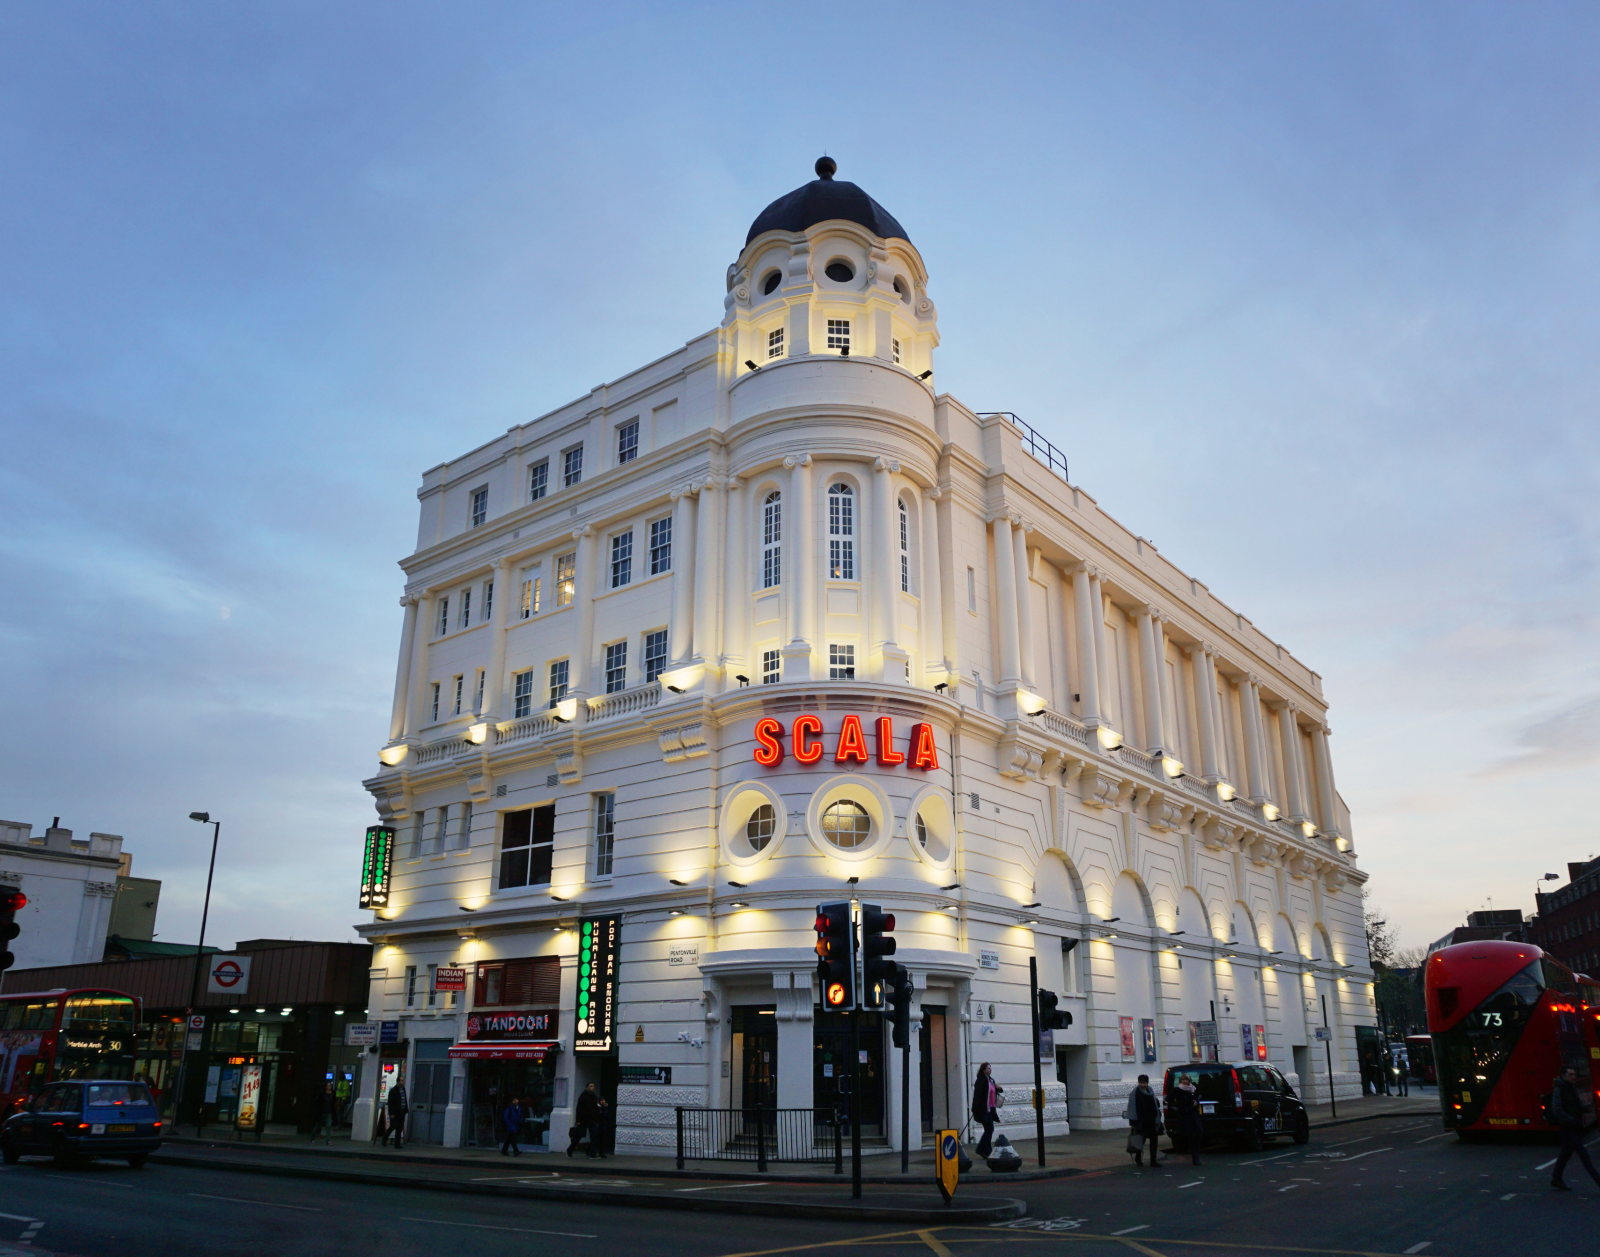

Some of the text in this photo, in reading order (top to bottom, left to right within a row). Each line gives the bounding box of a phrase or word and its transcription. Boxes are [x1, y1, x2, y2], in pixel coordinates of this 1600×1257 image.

[753, 714, 940, 771] SCALA
[383, 832, 393, 872] HURRICANE
[438, 969, 464, 977] INDIAN
[606, 954, 614, 976] BAR
[588, 921, 599, 1034] HURRICANE ROOM
[604, 982, 612, 1033] SNOOKER
[485, 1015, 548, 1031] TANDOORI
[1482, 1012, 1503, 1027] 73
[109, 1041, 121, 1051] 30
